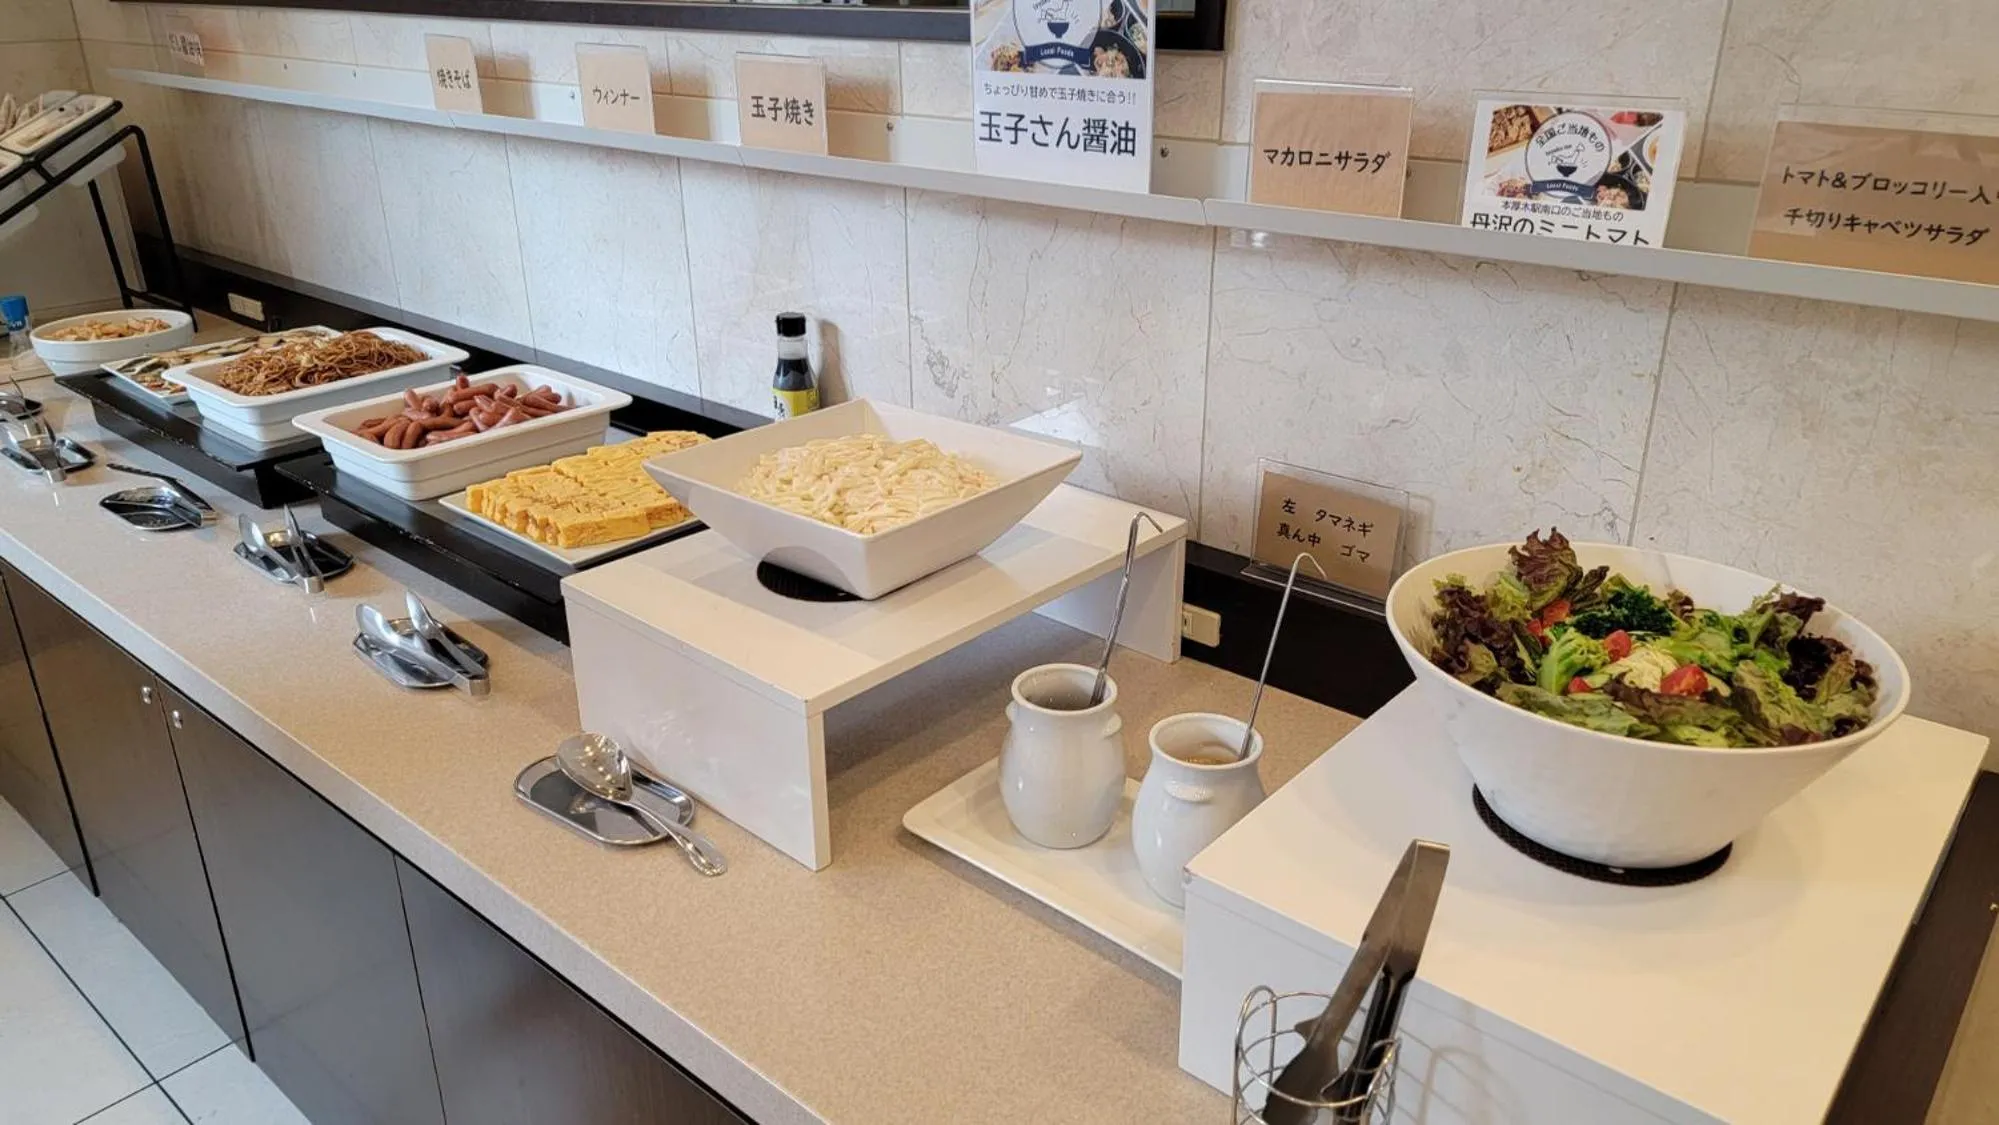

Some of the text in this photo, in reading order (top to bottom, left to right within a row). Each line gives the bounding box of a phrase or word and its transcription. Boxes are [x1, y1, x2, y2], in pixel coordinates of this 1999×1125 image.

[592, 87, 641, 106] ウィンナー
[751, 95, 815, 126] 玉子焼き
[978, 110, 1137, 157] 玉子さん醤油
[1535, 122, 1605, 152] 全国ご当地もの
[1263, 145, 1391, 174] マカロニサラダ
[1782, 165, 1999, 205] トマト&ブロッコリー入
[1784, 207, 1991, 246] 千切りキャベツサラダ
[1282, 498, 1374, 538] 左 タマネギ
[1276, 522, 1371, 563] 真ん中 ゴマ
